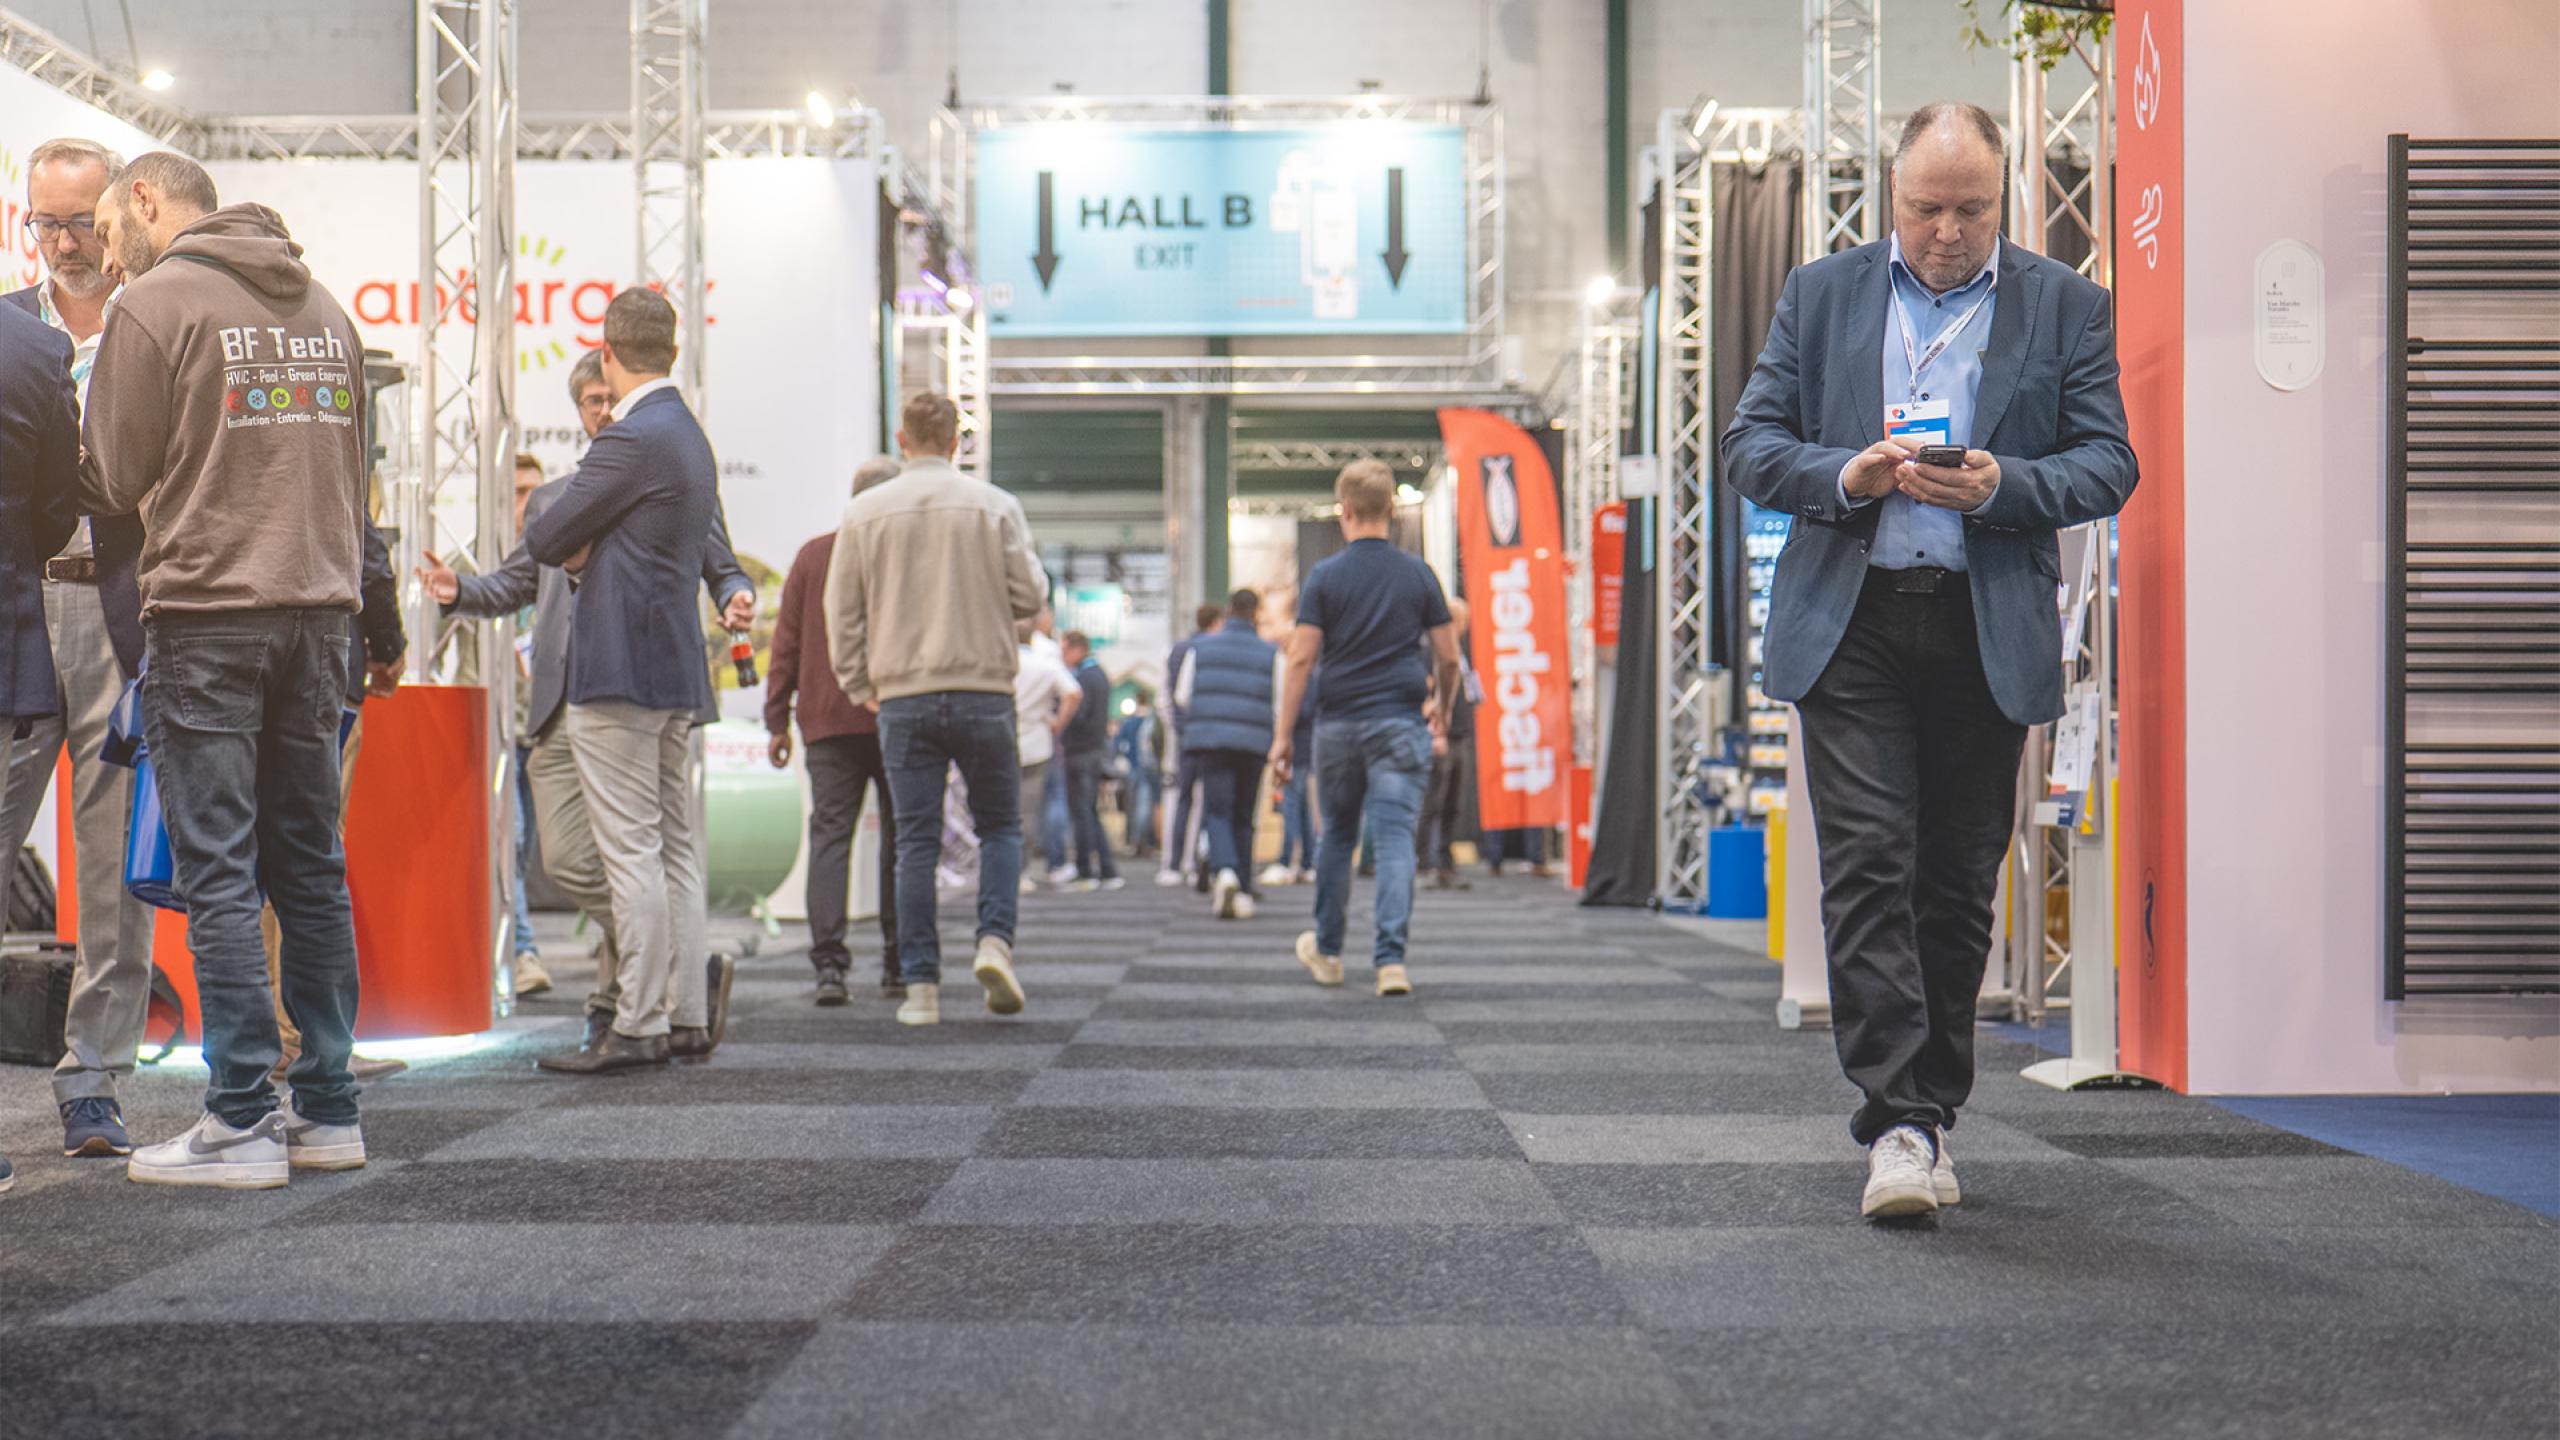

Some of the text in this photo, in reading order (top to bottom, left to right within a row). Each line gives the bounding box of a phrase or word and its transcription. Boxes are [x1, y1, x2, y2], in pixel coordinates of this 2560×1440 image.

[1079, 194, 1206, 229] HALL
[1223, 193, 1253, 229] B
[1134, 242, 1197, 271] EXIT
[218, 326, 344, 362] BF Tech
[287, 366, 317, 382] Green
[318, 366, 348, 386] Energy
